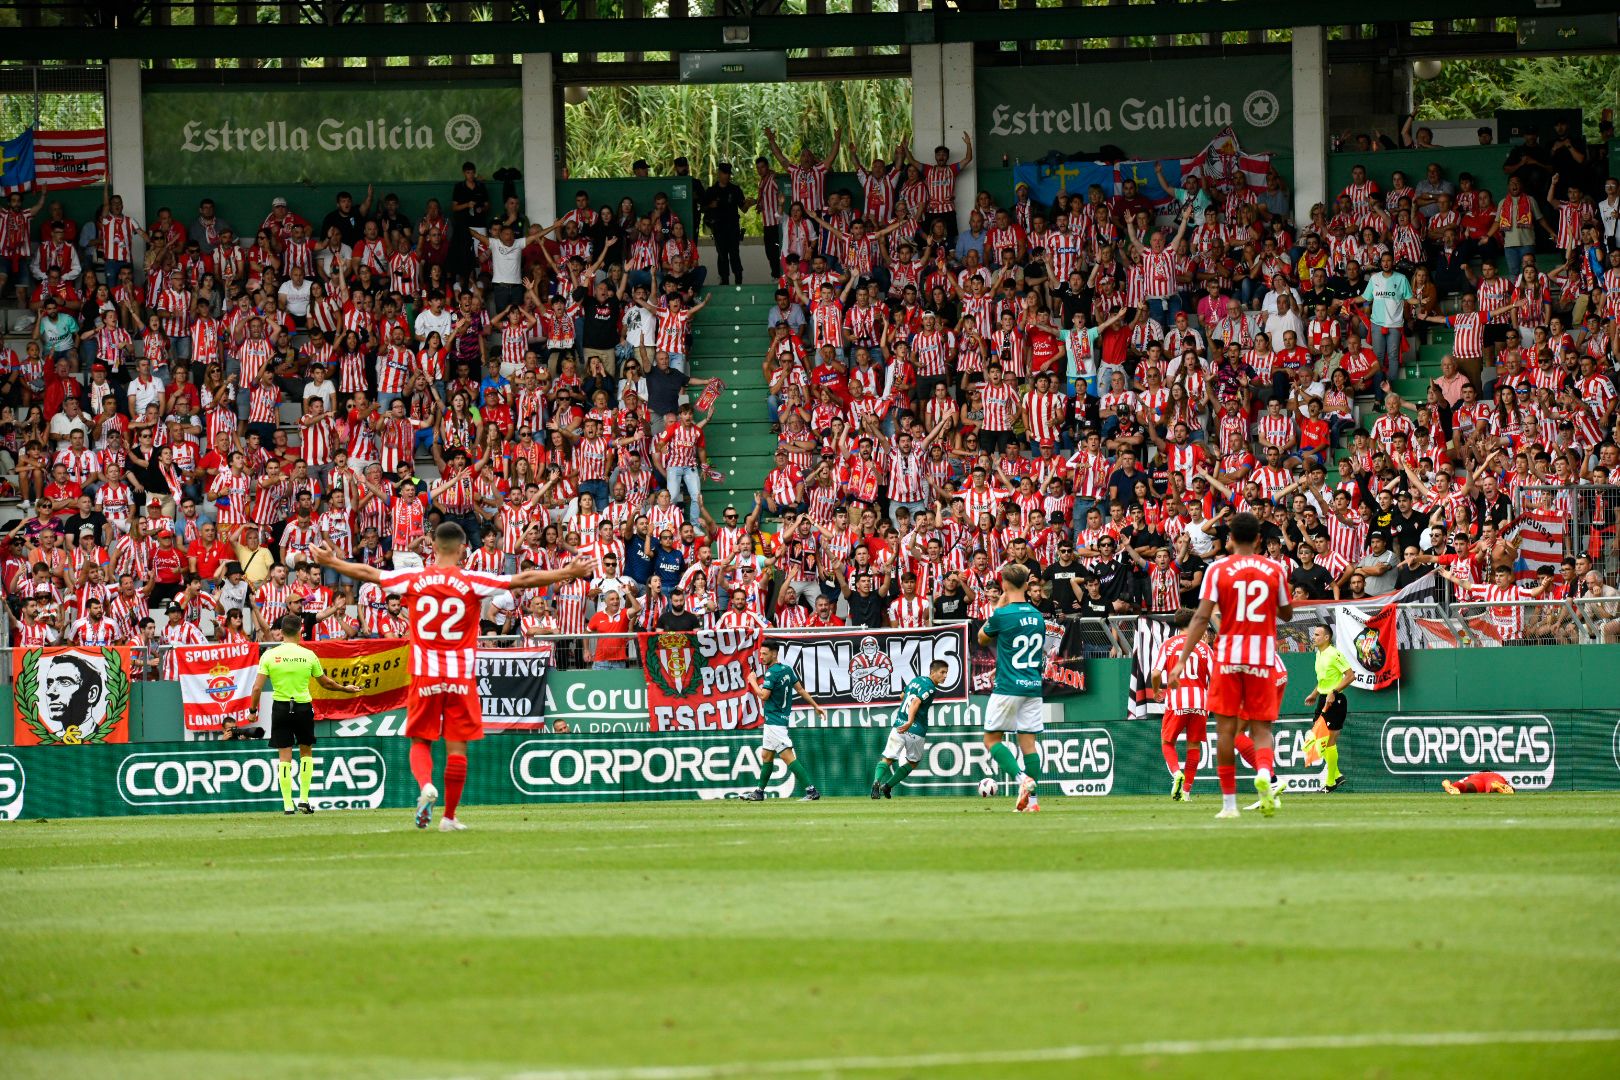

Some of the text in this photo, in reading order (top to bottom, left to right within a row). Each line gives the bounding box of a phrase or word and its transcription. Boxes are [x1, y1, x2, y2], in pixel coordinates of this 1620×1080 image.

[989, 101, 1113, 136] Estrella
[1120, 95, 1233, 131] Galicia
[181, 119, 310, 153] Estrella
[317, 117, 435, 151] Galicia
[413, 574, 470, 595] RÓBER PIER
[1232, 580, 1270, 623] 12
[415, 595, 466, 641] 22
[1019, 616, 1039, 627] IKER
[185, 643, 250, 663] SPORTING
[1011, 632, 1043, 670] 22
[475, 658, 546, 677] RTING
[700, 659, 746, 696] POR
[1174, 650, 1199, 680] 10
[1219, 664, 1270, 679] NISSAN
[418, 682, 469, 698] NISSAN
[477, 677, 492, 696] &
[654, 691, 764, 732] ESCUD
[1174, 707, 1207, 717] NISSAN
[1385, 726, 1551, 765] CORPOREAS
[1069, 782, 1107, 794] .com
